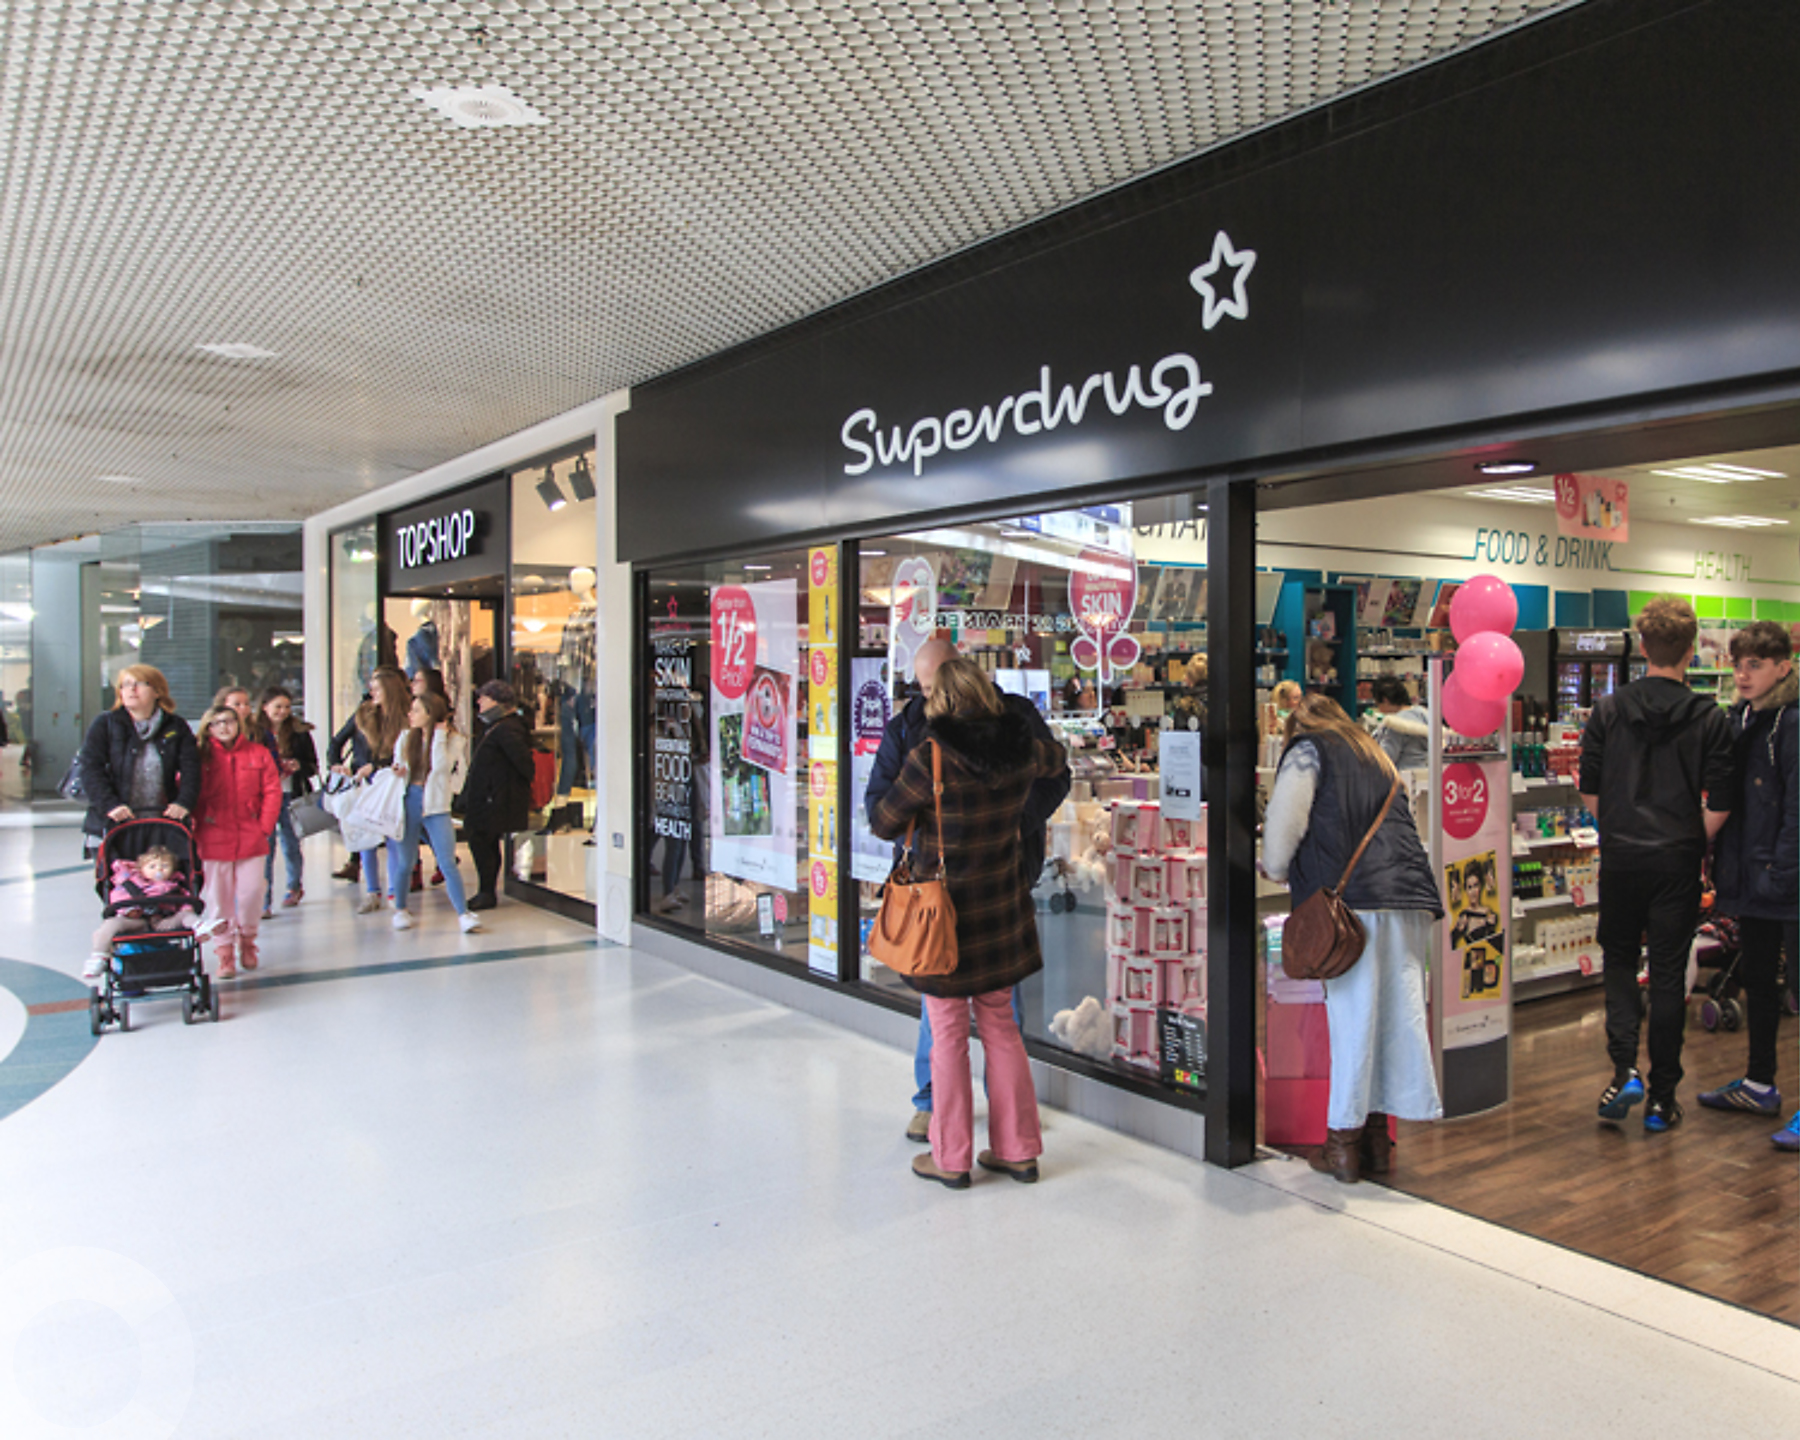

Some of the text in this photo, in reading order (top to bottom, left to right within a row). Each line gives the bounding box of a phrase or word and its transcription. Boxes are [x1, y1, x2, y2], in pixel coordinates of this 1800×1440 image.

[841, 352, 1213, 477] Superdrug
[397, 508, 475, 569] TOPSHOP
[1475, 527, 1613, 571] FOOD & DRINK
[1694, 549, 1753, 582] HEALTH
[1081, 592, 1122, 616] SKIN
[654, 657, 692, 687] SKIN
[655, 753, 692, 782] FOOD
[655, 782, 692, 804] BEAUTY
[1444, 779, 1484, 805] 3 for 2
[655, 816, 692, 840] HEALTH
